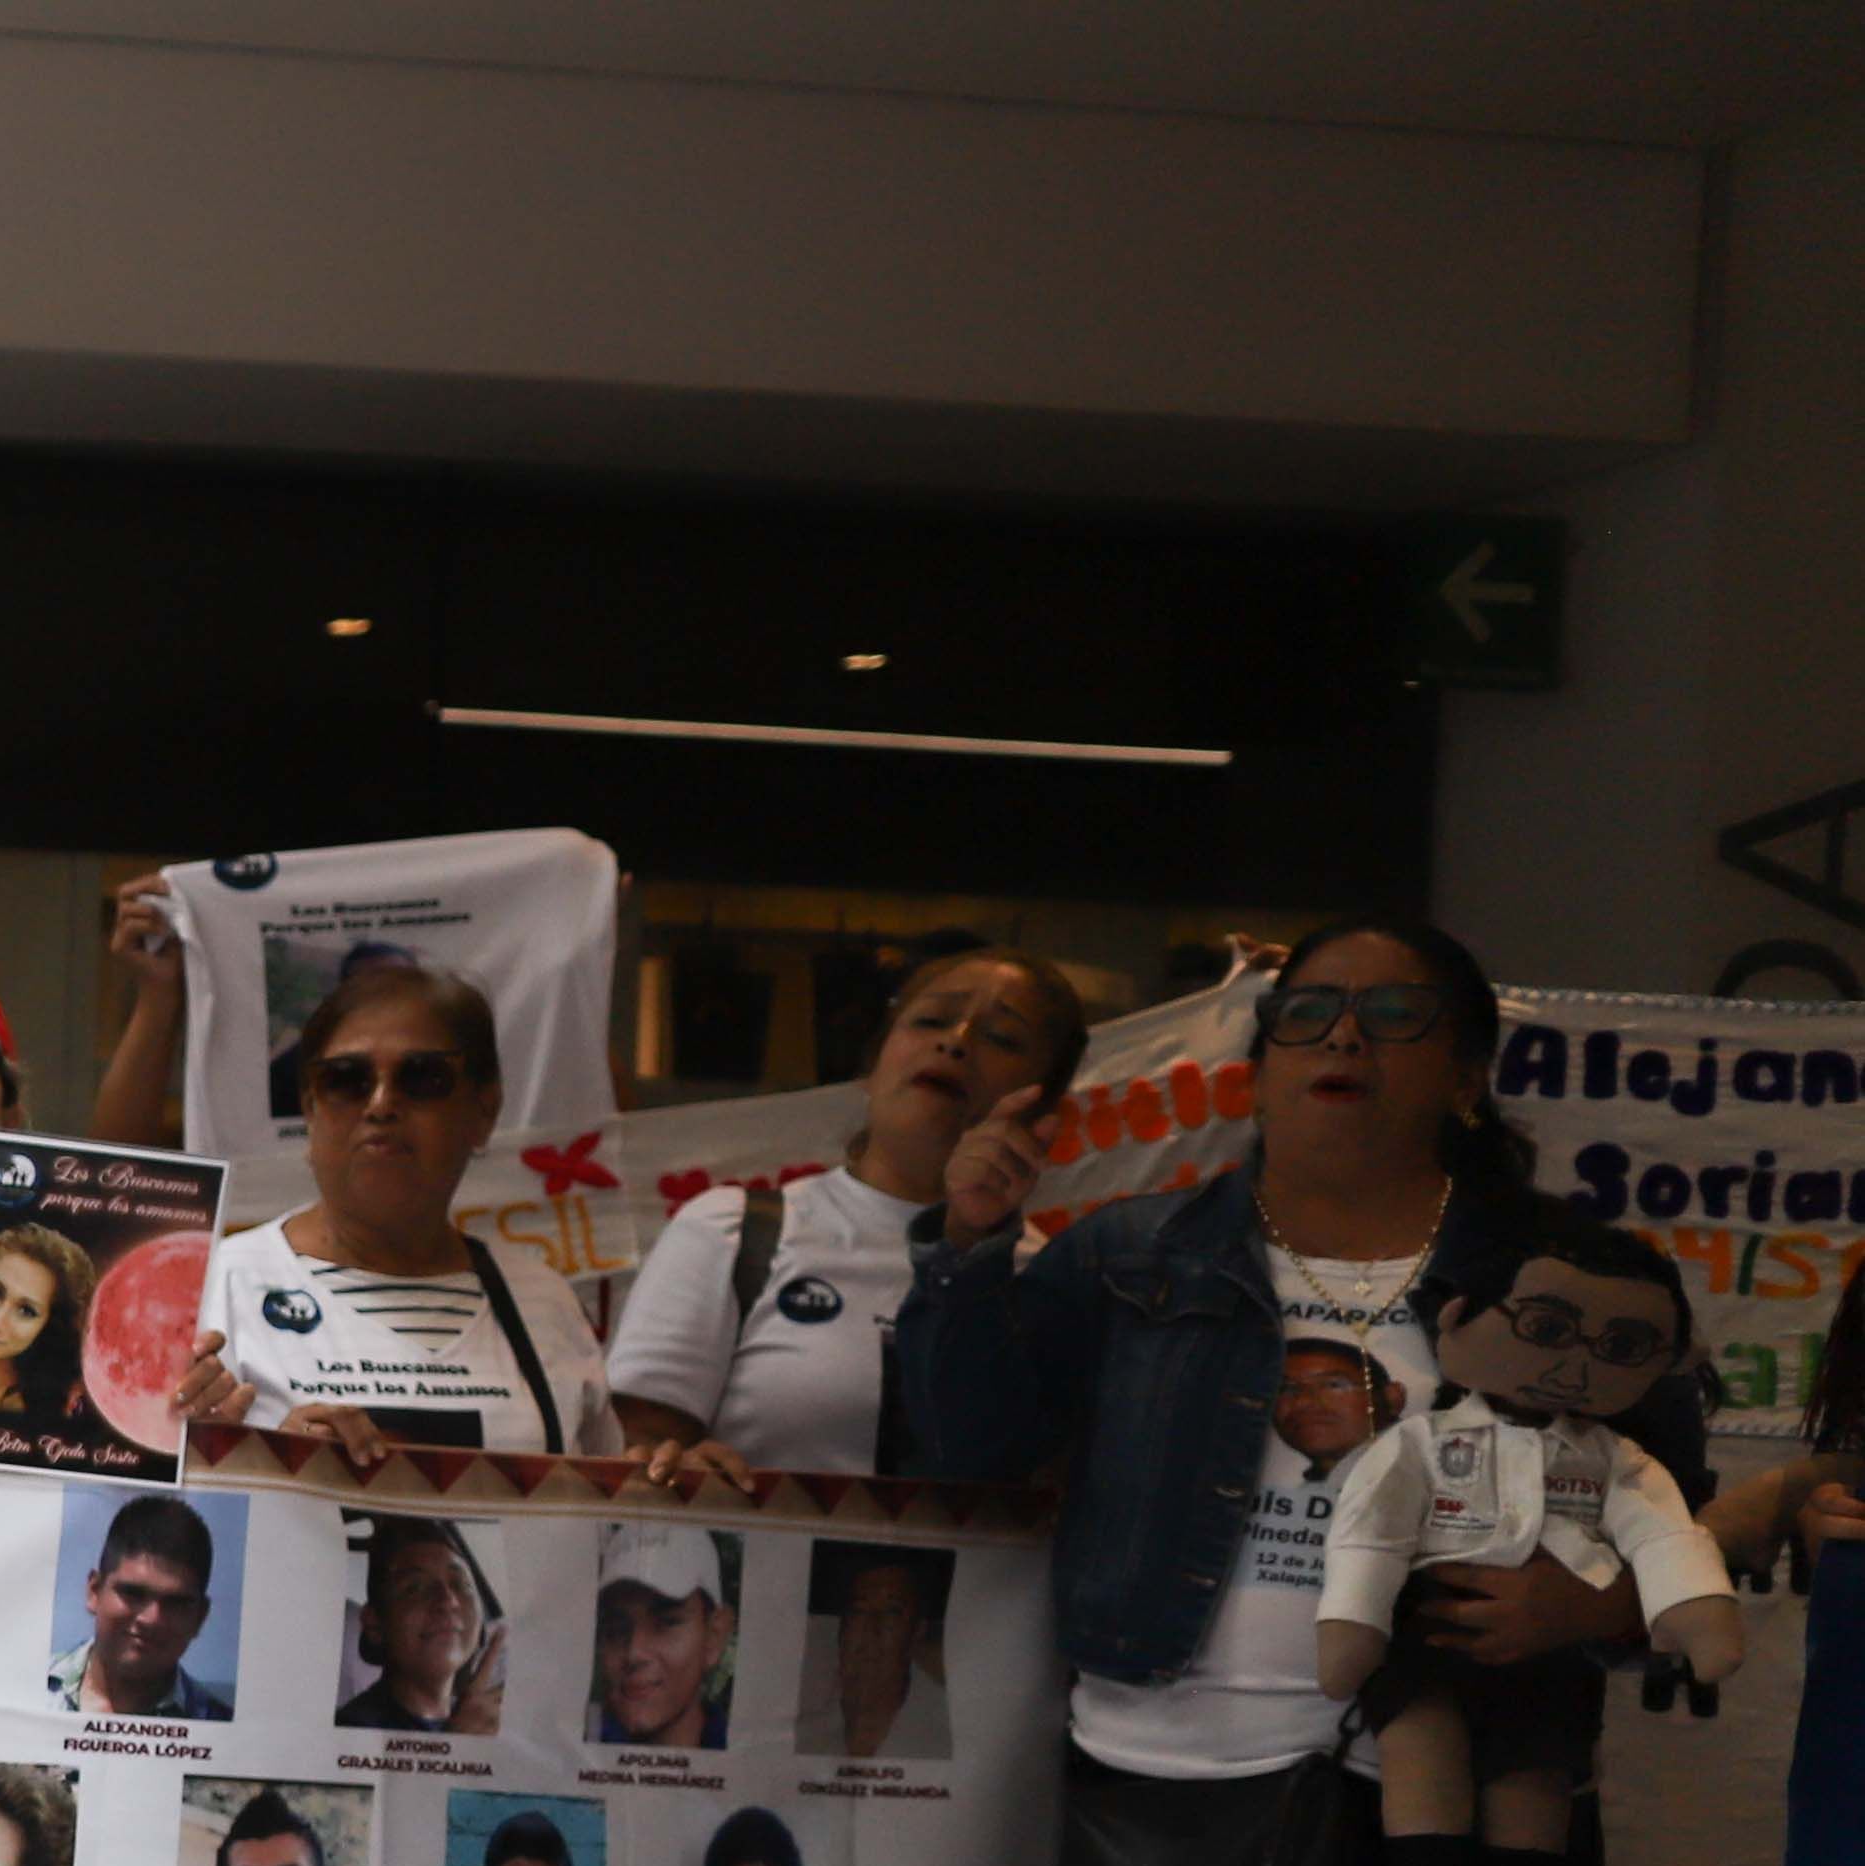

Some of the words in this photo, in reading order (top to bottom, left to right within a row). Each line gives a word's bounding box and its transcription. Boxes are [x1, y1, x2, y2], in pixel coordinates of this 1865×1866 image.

[316, 1358, 354, 1376] Los
[360, 1358, 471, 1377] Buscamos
[374, 1379, 407, 1397] los
[413, 1379, 511, 1400] Amamos
[82, 1721, 189, 1738] ALEXANDER
[62, 1738, 151, 1758] FIGUEROA
[154, 1740, 213, 1761] LÓPEZ
